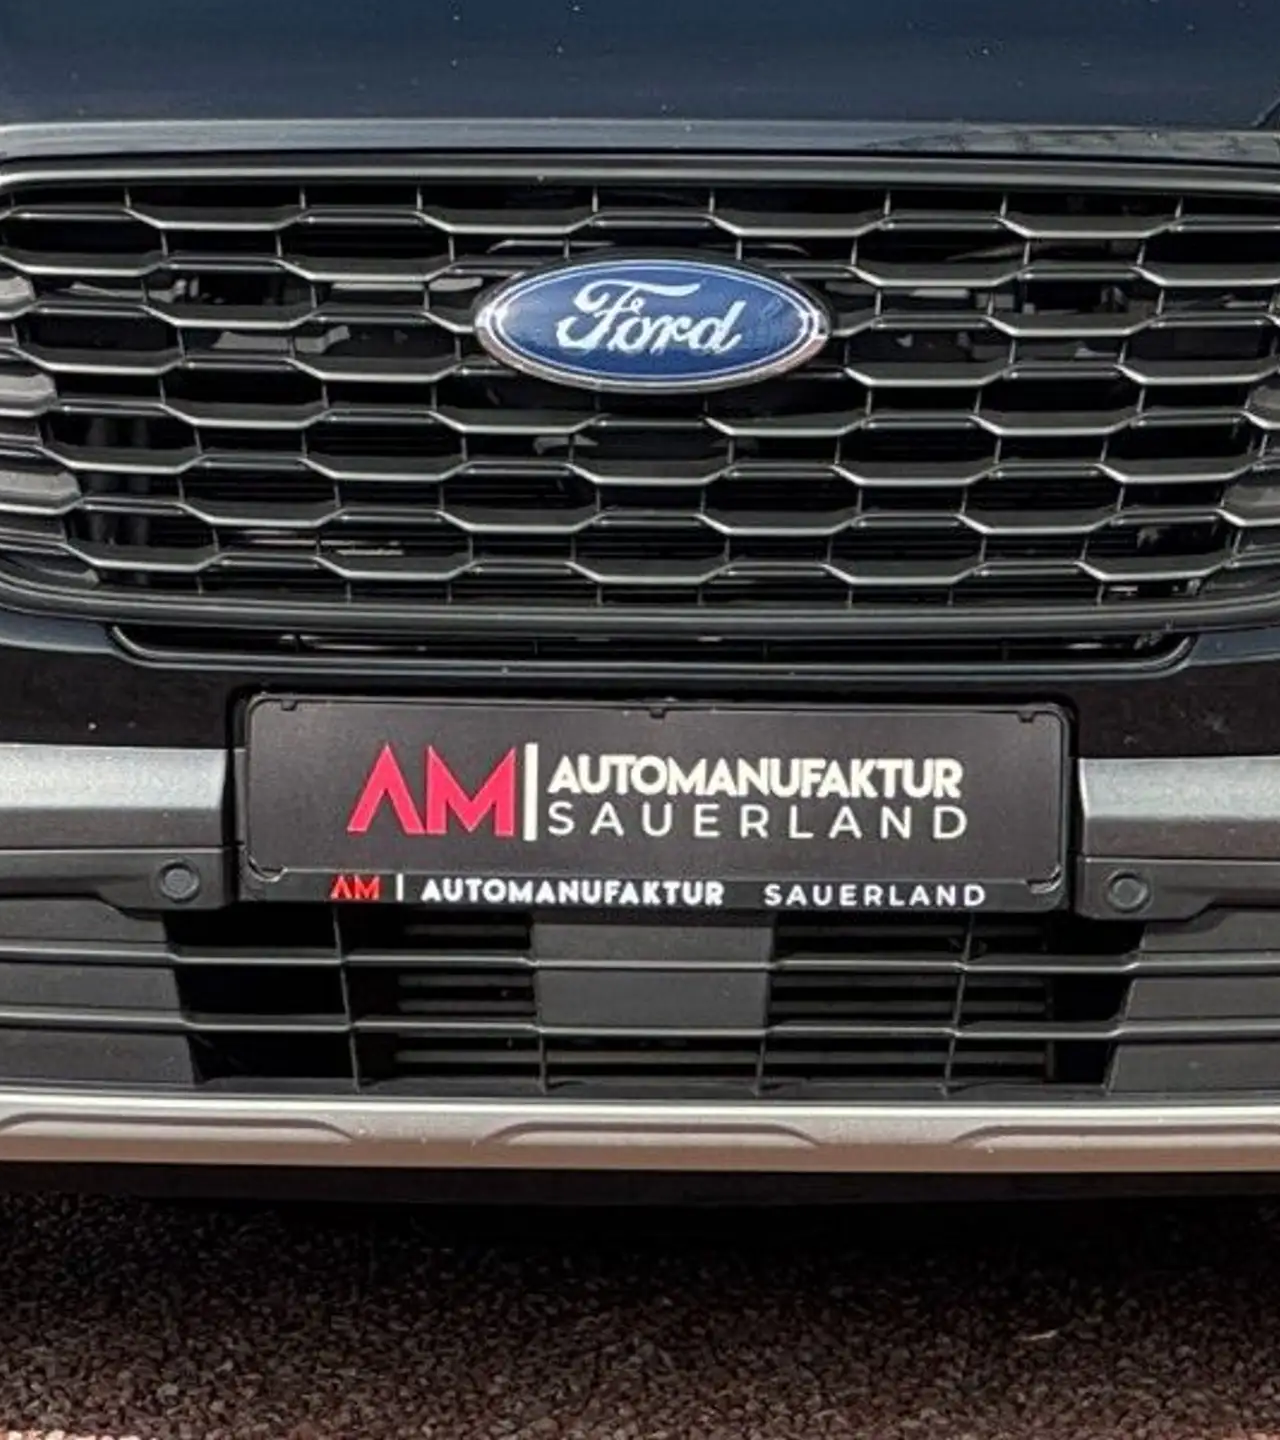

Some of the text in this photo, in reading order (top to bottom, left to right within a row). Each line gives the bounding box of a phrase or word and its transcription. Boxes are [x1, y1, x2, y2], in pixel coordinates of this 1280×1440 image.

[556, 279, 746, 354] Ford
[347, 743, 516, 837] AM
[547, 754, 964, 799] AUTOMANUFAKTUR
[547, 800, 968, 840] SAUERLAND
[330, 873, 986, 907] AM AUTOMANUFAKTUR SAUERLAND
